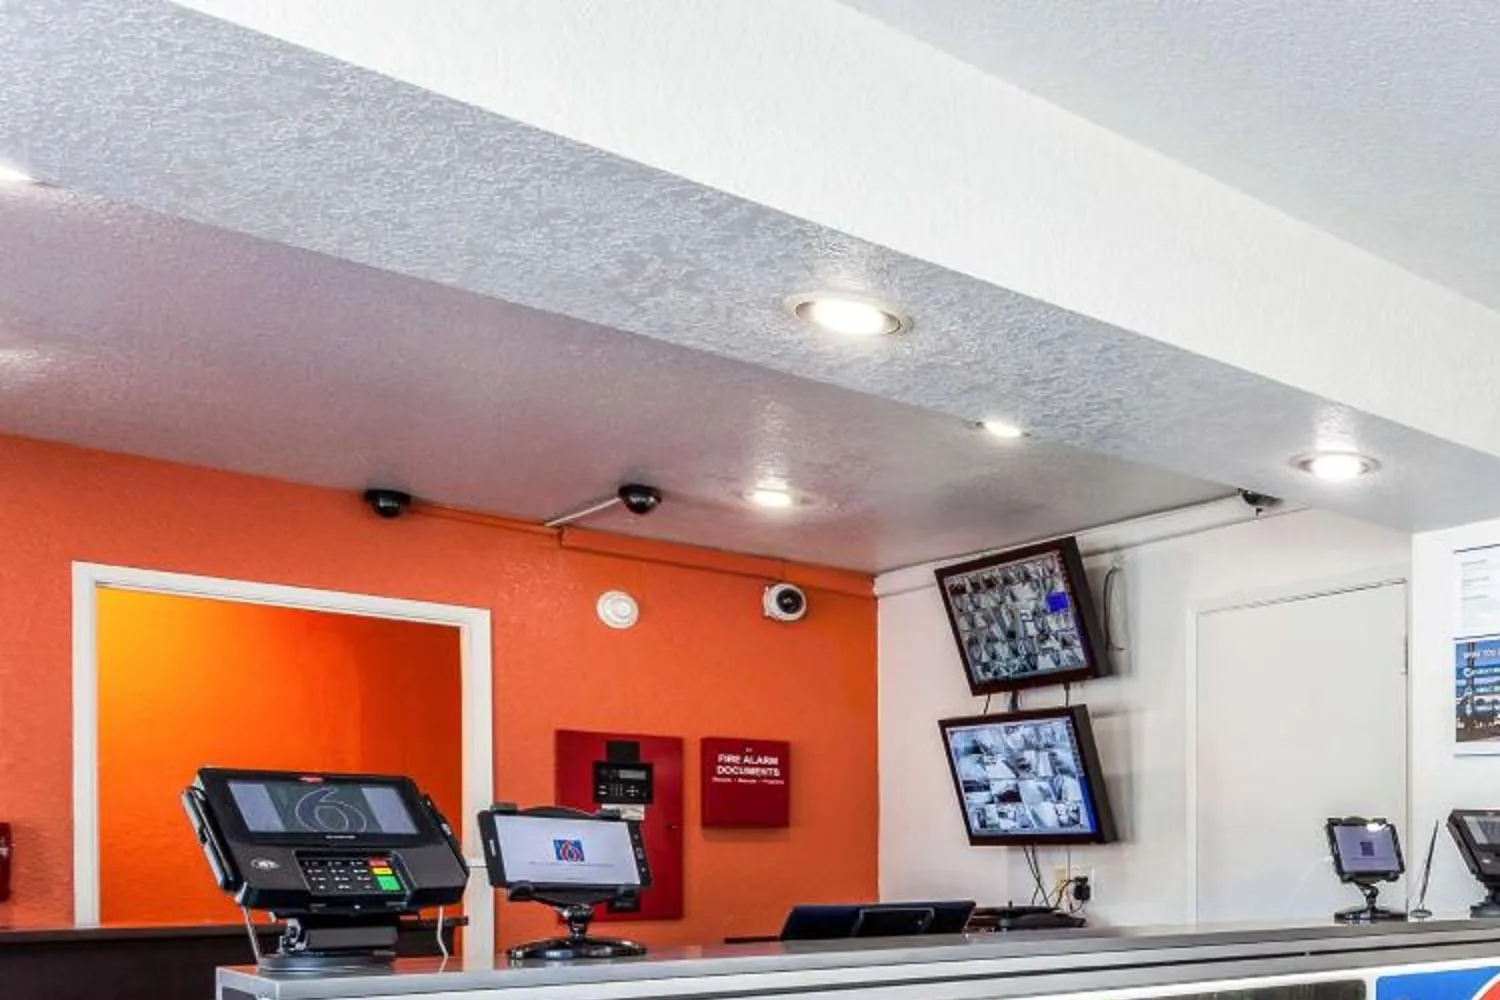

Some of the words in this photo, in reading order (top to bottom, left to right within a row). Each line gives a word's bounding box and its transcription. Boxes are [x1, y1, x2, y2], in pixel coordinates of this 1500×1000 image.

[717, 753, 741, 764] FIRE
[743, 755, 779, 765] ALARM
[716, 765, 781, 777] DOCUMENTS
